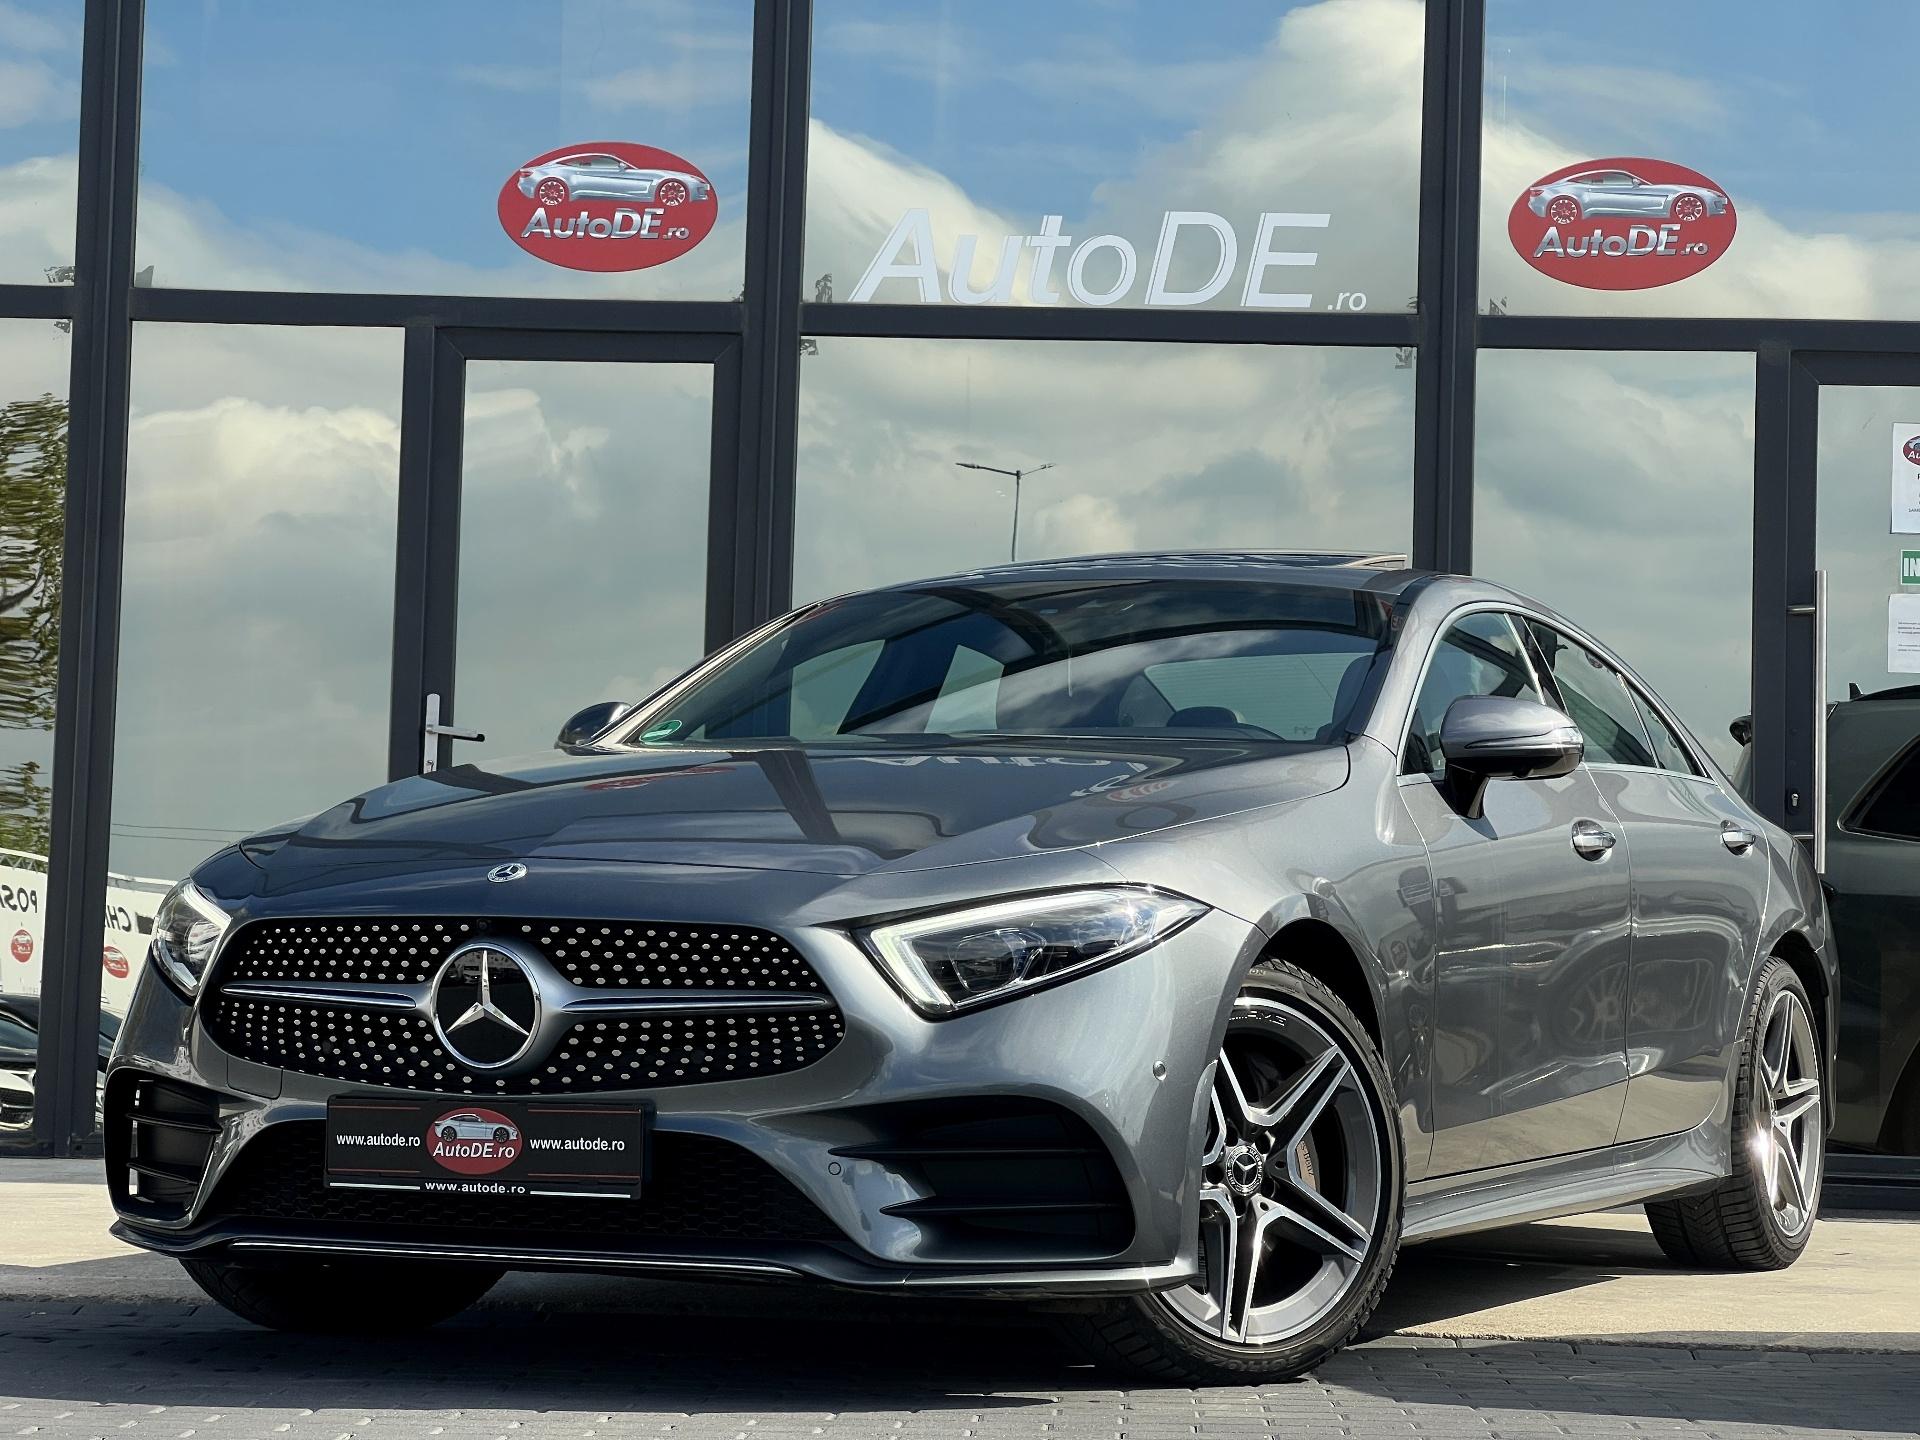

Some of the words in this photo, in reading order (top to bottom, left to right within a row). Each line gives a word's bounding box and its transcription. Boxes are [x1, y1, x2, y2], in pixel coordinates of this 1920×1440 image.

[336, 1133, 420, 1148] www.autode.ro
[529, 1136, 625, 1151] www.autode.ro
[432, 1142, 515, 1159] AutoDE.ro
[425, 1181, 526, 1194] www.autode.ro
